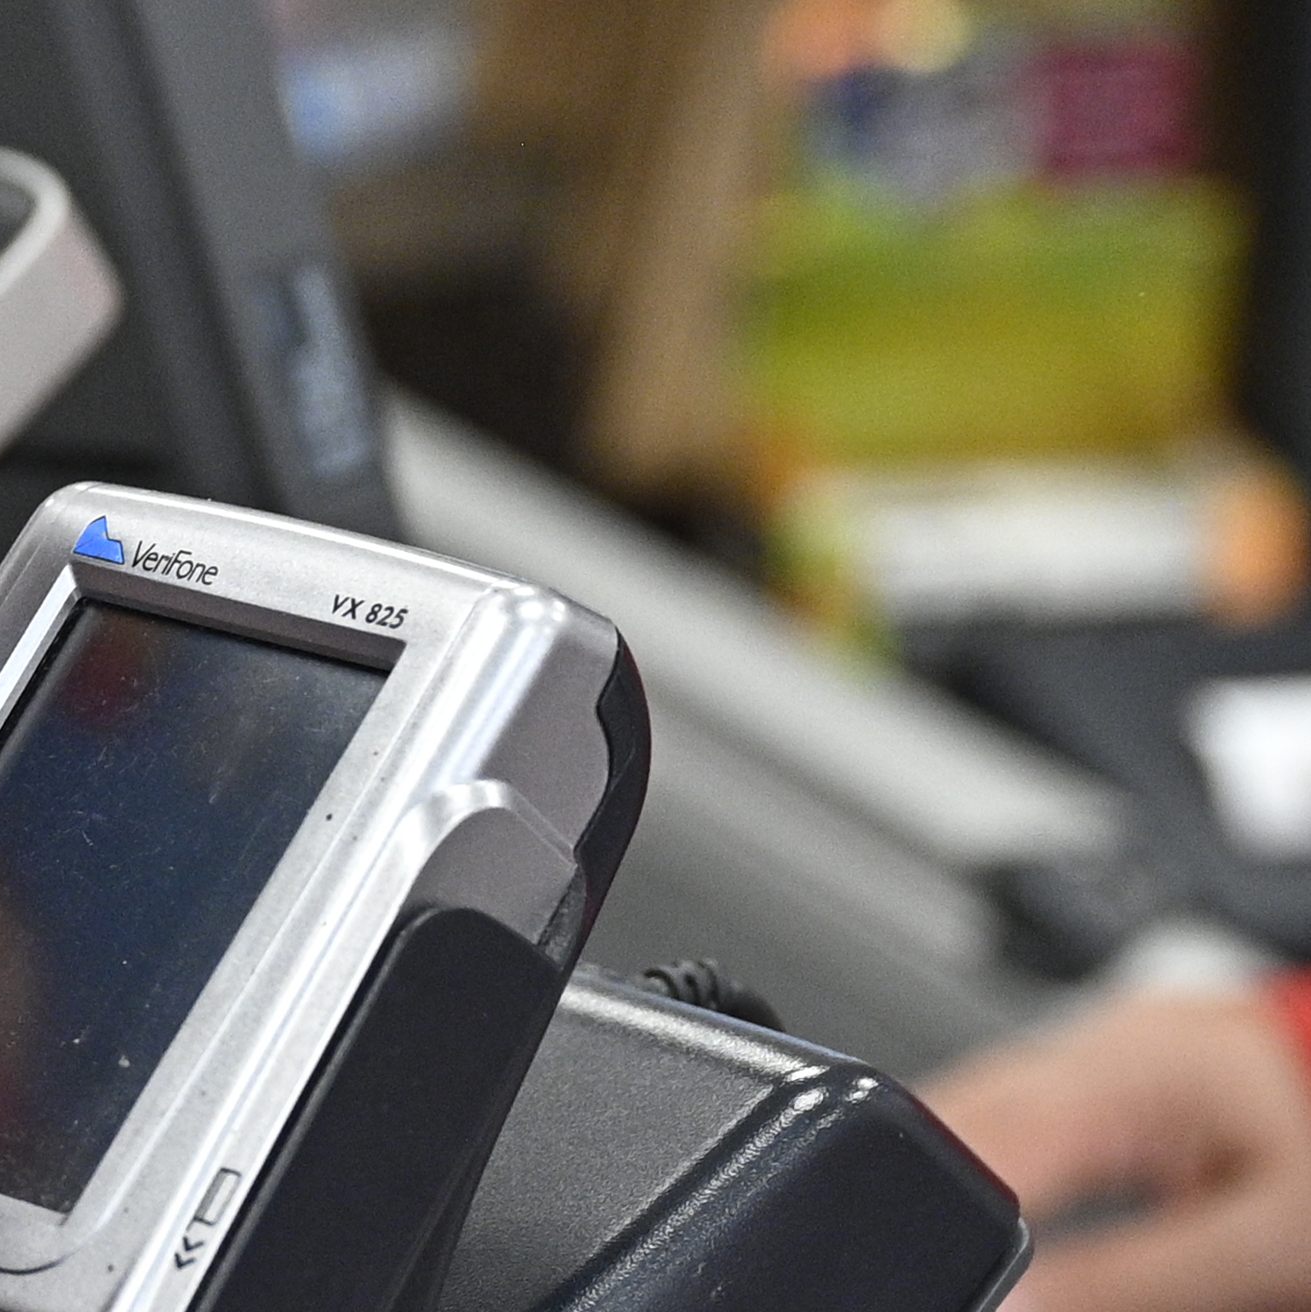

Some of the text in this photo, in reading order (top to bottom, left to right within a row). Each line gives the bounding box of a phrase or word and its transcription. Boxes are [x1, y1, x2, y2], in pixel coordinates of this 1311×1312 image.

[131, 540, 219, 586] VeriFone
[331, 594, 409, 630] VX 825
